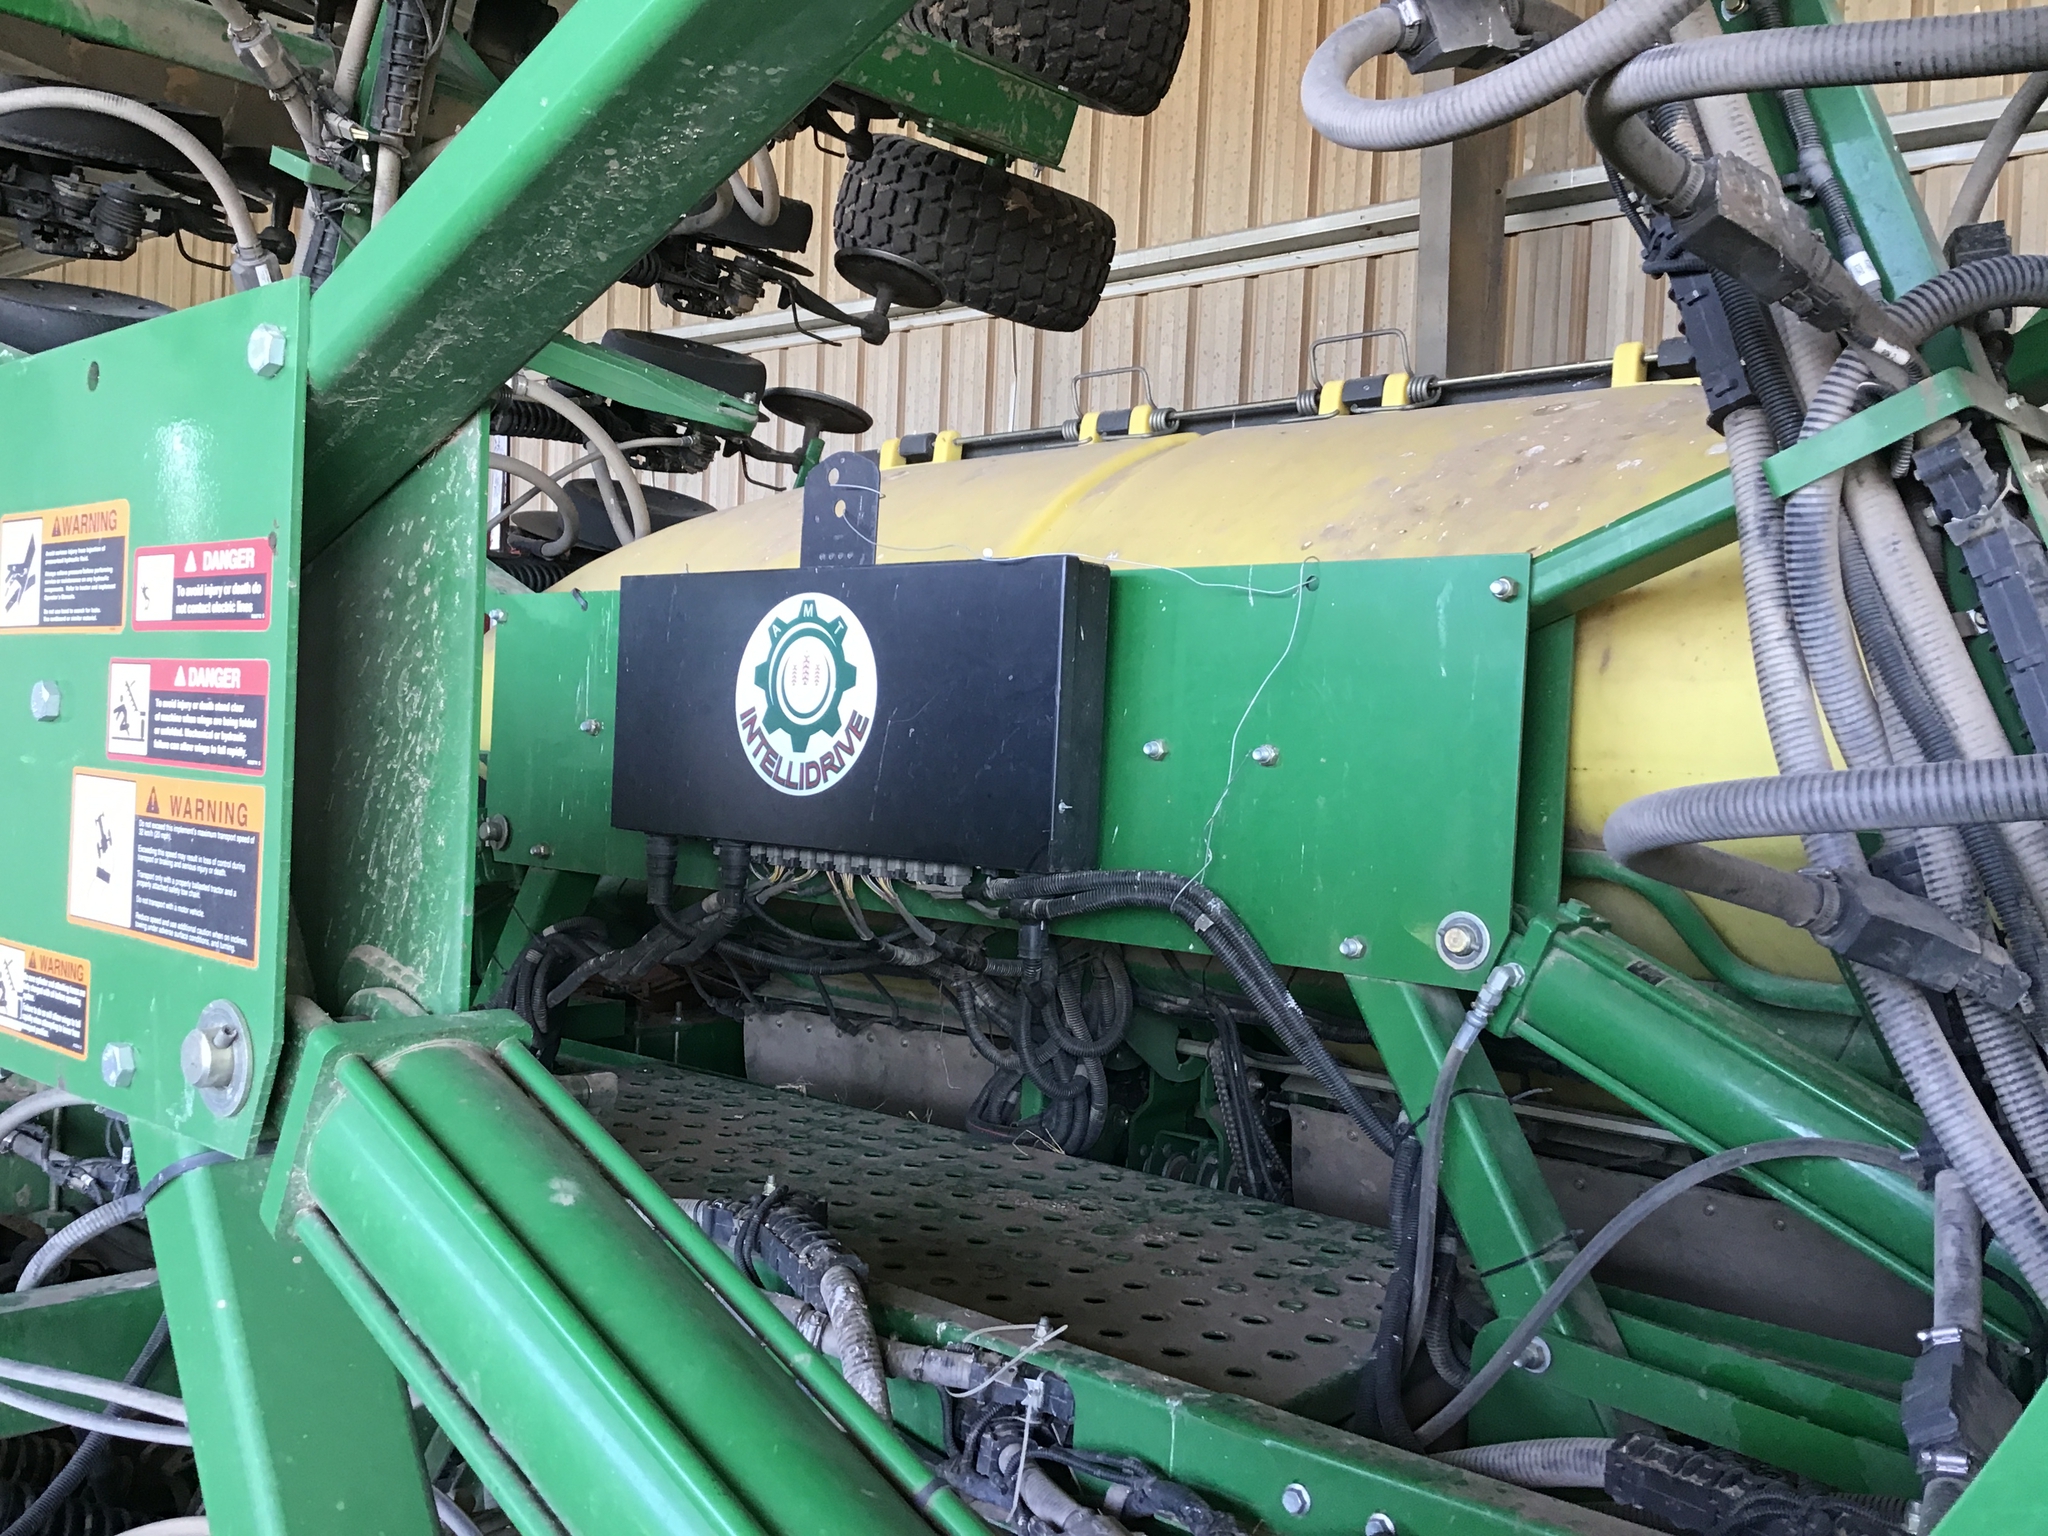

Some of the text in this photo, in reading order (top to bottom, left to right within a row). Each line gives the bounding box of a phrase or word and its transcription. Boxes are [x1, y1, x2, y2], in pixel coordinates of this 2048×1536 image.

[62, 509, 117, 536] WARNING
[202, 547, 255, 571] DANGER
[177, 583, 262, 598] To avoid injury or death do
[176, 601, 253, 614] not contact electric lines
[188, 667, 241, 689] DANGER
[740, 706, 869, 790] INTELLIDRIVE
[170, 795, 248, 827] WARNING
[40, 955, 84, 982] WARNING
